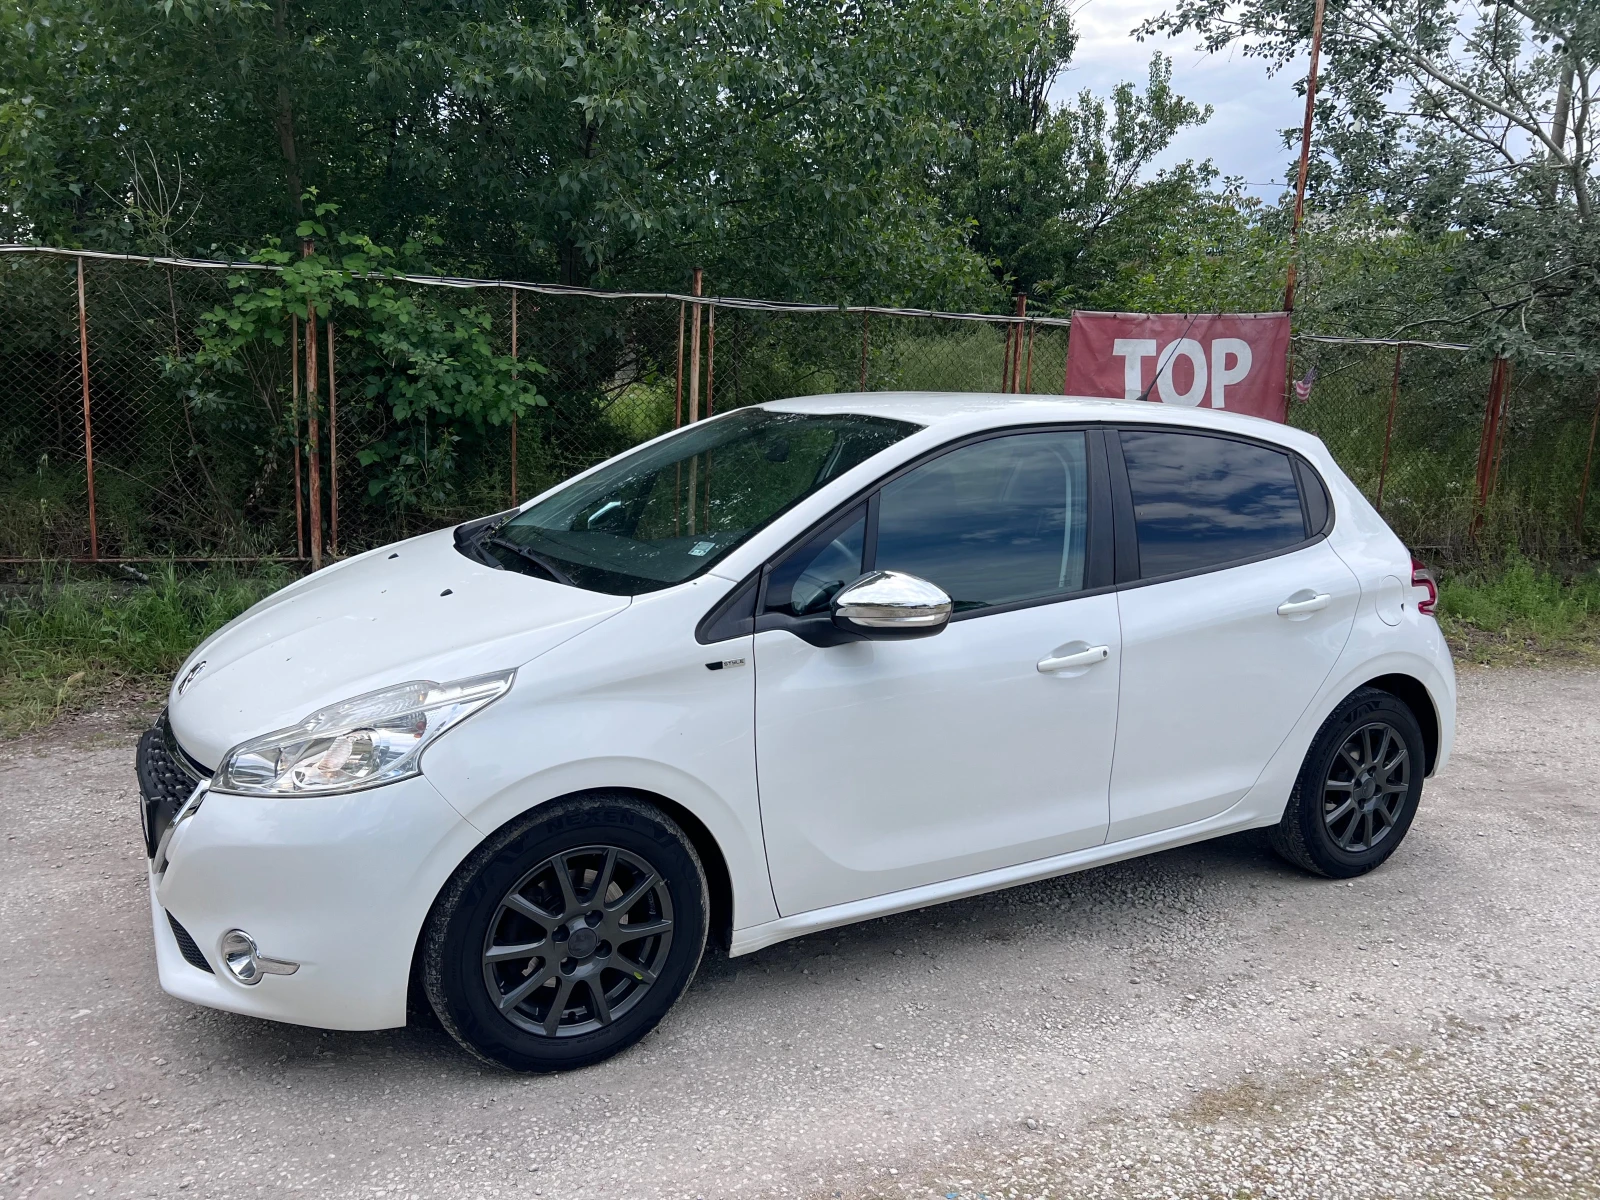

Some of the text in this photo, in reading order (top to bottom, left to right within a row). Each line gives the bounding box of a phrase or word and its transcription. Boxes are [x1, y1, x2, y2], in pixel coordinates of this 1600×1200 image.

[1112, 338, 1252, 408] TOP
[724, 659, 744, 667] STYLE
[546, 807, 635, 833] NEXEN
